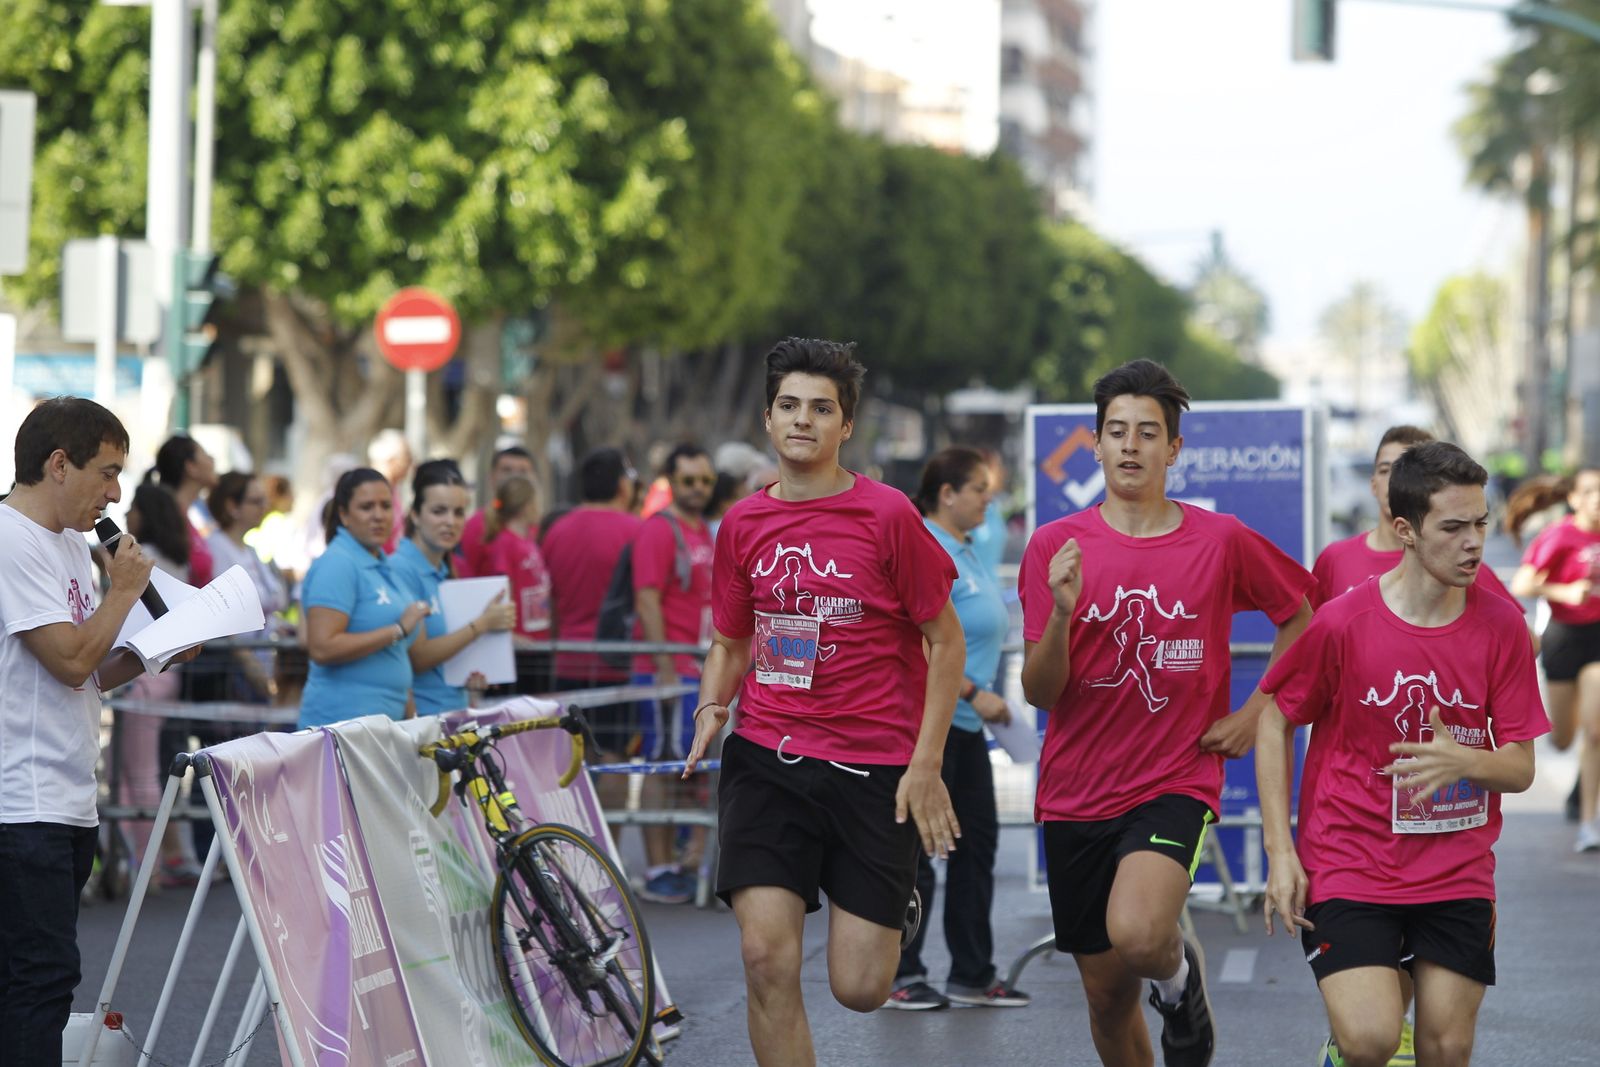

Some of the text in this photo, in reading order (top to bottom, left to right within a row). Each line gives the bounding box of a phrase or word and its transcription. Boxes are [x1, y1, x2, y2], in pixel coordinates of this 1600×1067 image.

[820, 596, 862, 607] CARRERA
[820, 605, 862, 615] SOLIDARIA
[768, 636, 816, 660] 1808
[1151, 640, 1164, 669] 4
[1166, 639, 1203, 649] CARRERA
[1164, 650, 1203, 659] SOLIDARIA
[1432, 800, 1479, 812] PABLO ANTONIO
